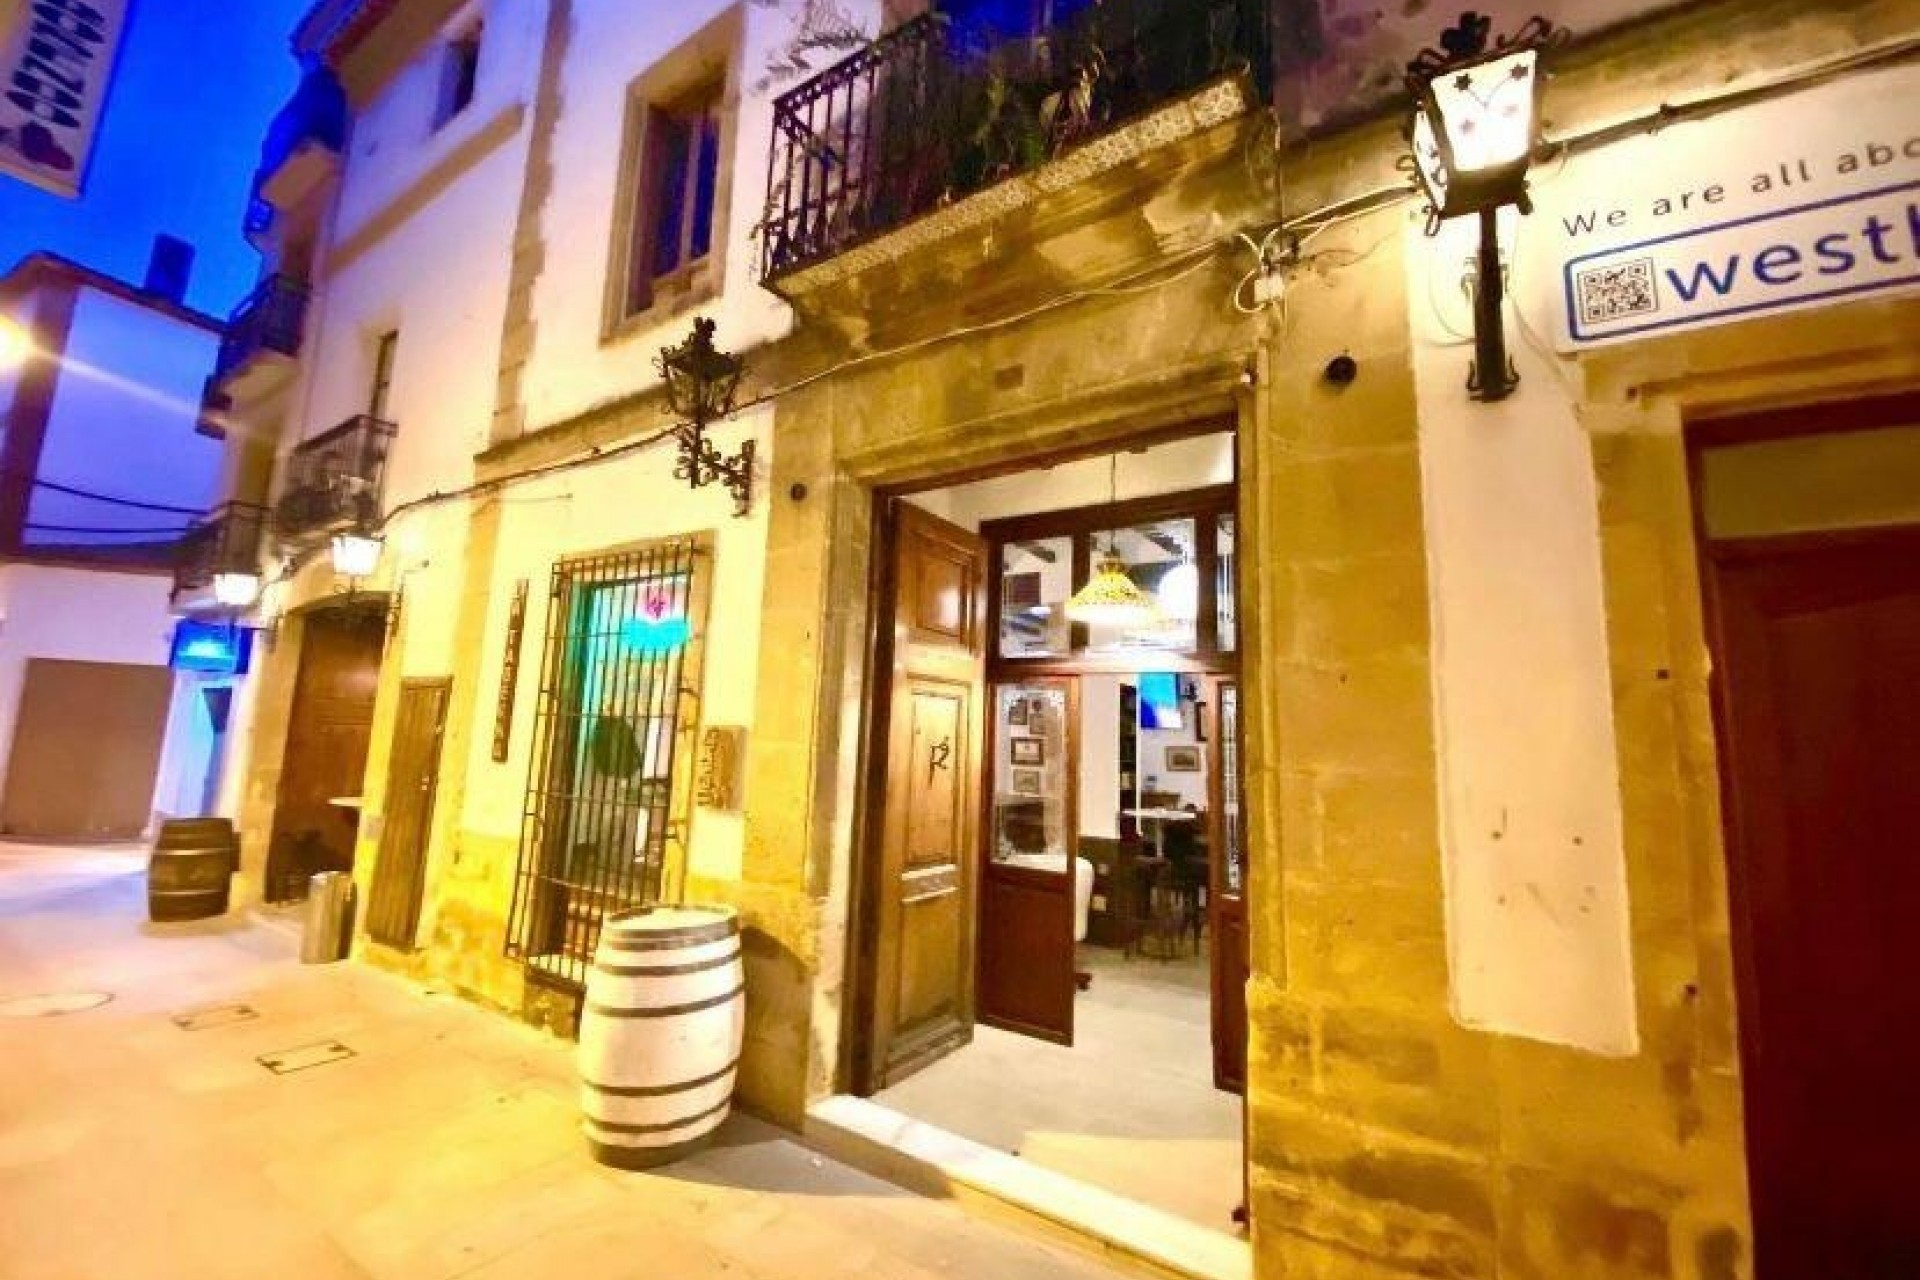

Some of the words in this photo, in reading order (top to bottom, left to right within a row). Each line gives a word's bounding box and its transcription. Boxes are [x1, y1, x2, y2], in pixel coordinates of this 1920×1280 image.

[1562, 209, 1627, 238] We
[1652, 184, 1725, 217] are
[1751, 159, 1812, 193] all
